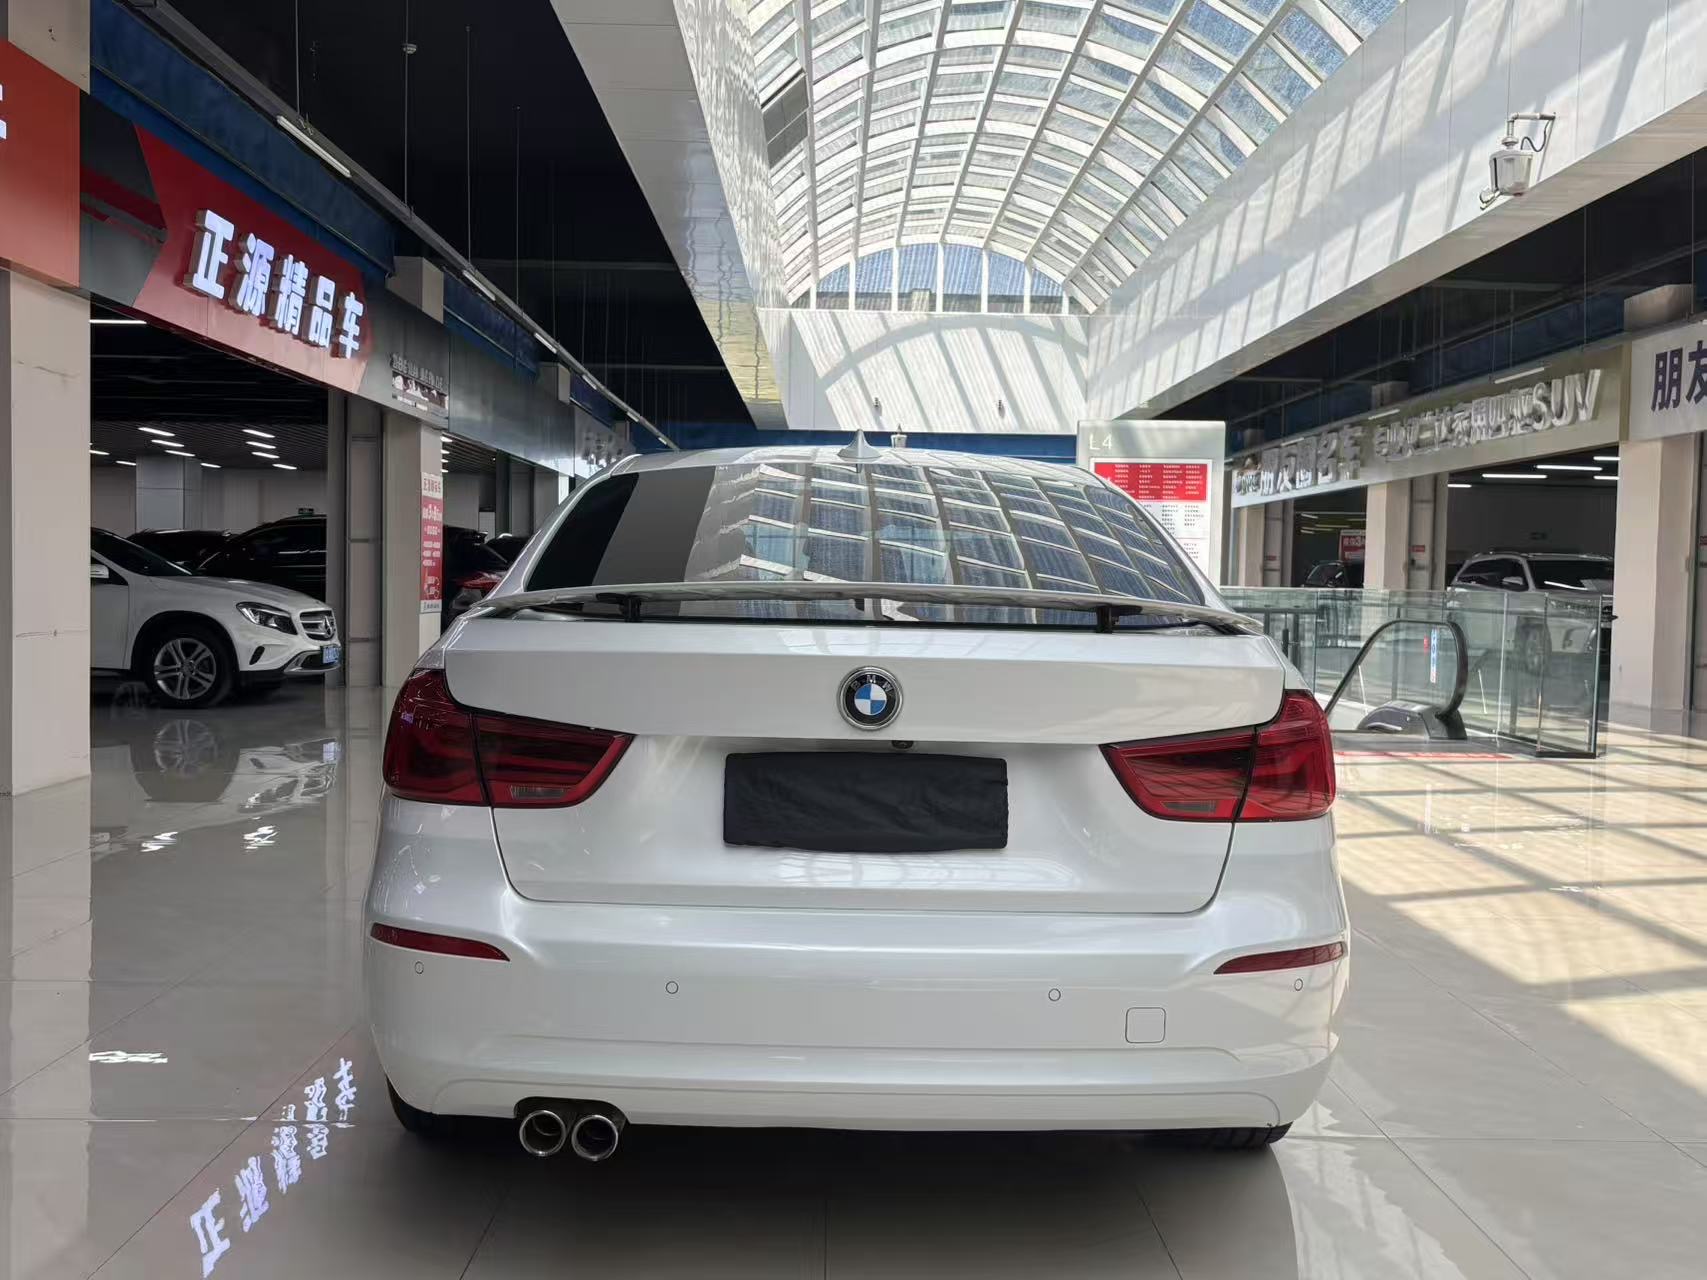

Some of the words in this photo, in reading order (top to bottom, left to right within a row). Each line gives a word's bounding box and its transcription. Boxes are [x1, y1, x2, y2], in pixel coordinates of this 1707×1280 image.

[191, 209, 364, 360] 正源精品车
[1088, 433, 1113, 450] L4
[850, 674, 894, 692] BMW
